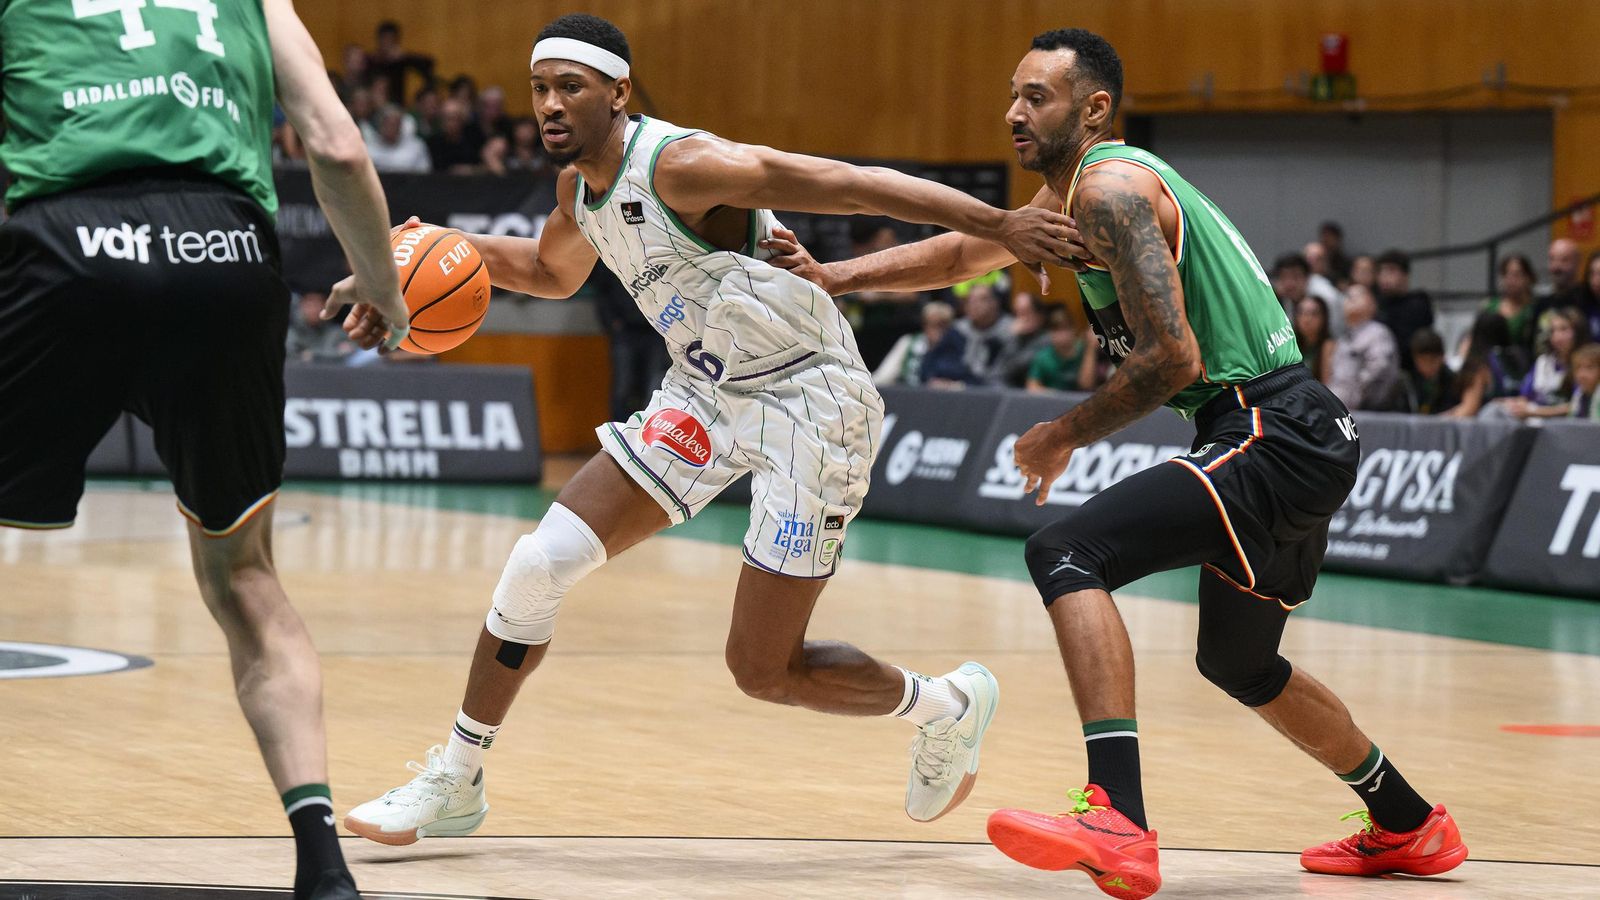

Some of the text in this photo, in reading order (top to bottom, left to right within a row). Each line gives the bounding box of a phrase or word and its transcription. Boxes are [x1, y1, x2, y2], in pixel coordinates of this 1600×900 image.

[62, 75, 169, 110] BADALONA
[76, 223, 263, 264] vdf team
[285, 398, 524, 451] STRELLA
[338, 448, 440, 480] DAMM
[1345, 448, 1464, 513] GVSA
[825, 520, 841, 529] acb
